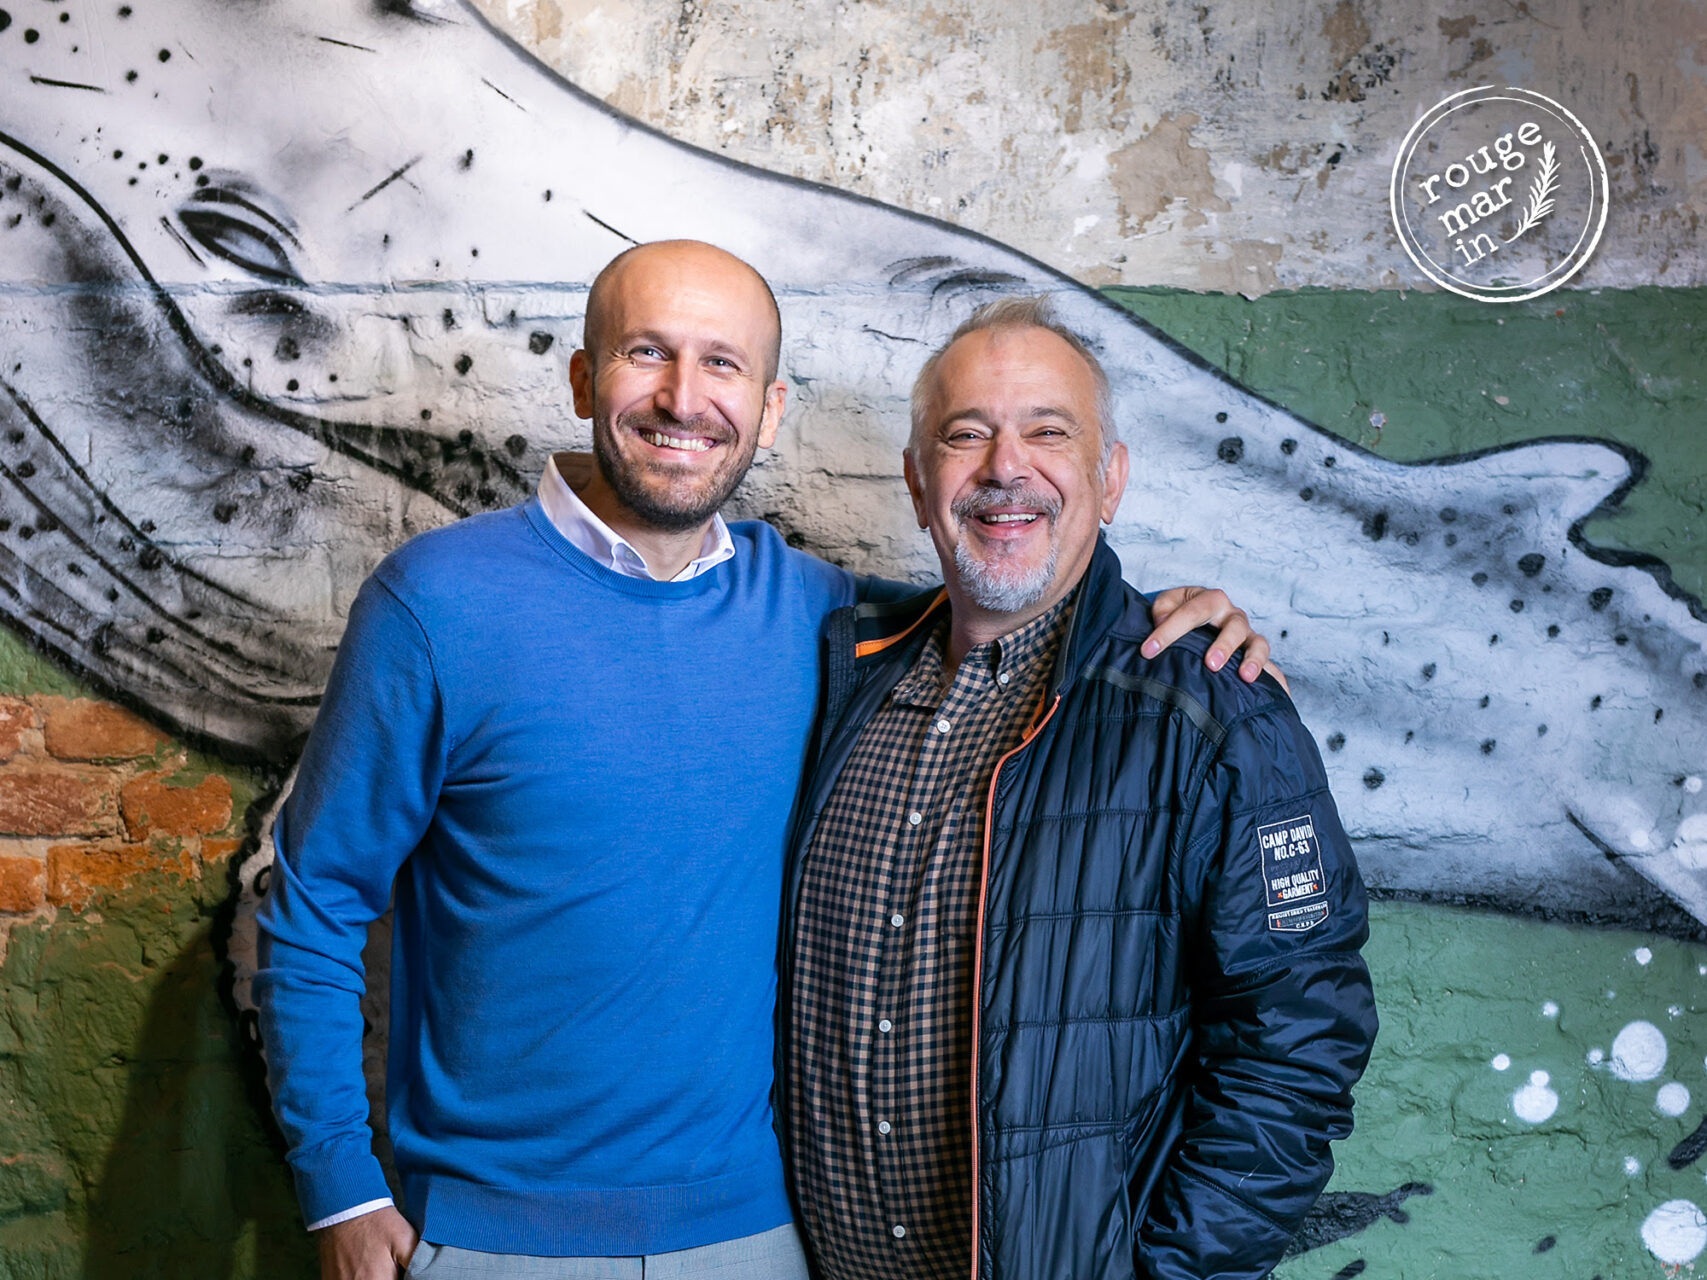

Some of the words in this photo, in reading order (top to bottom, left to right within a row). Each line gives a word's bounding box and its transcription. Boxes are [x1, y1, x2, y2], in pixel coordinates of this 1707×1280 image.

[1262, 829, 1288, 849] CAMP
[1290, 824, 1313, 842] DAVID
[1271, 876, 1291, 891] HIGH
[1291, 868, 1319, 888] QUALITY
[1282, 882, 1314, 899] GARMENT
